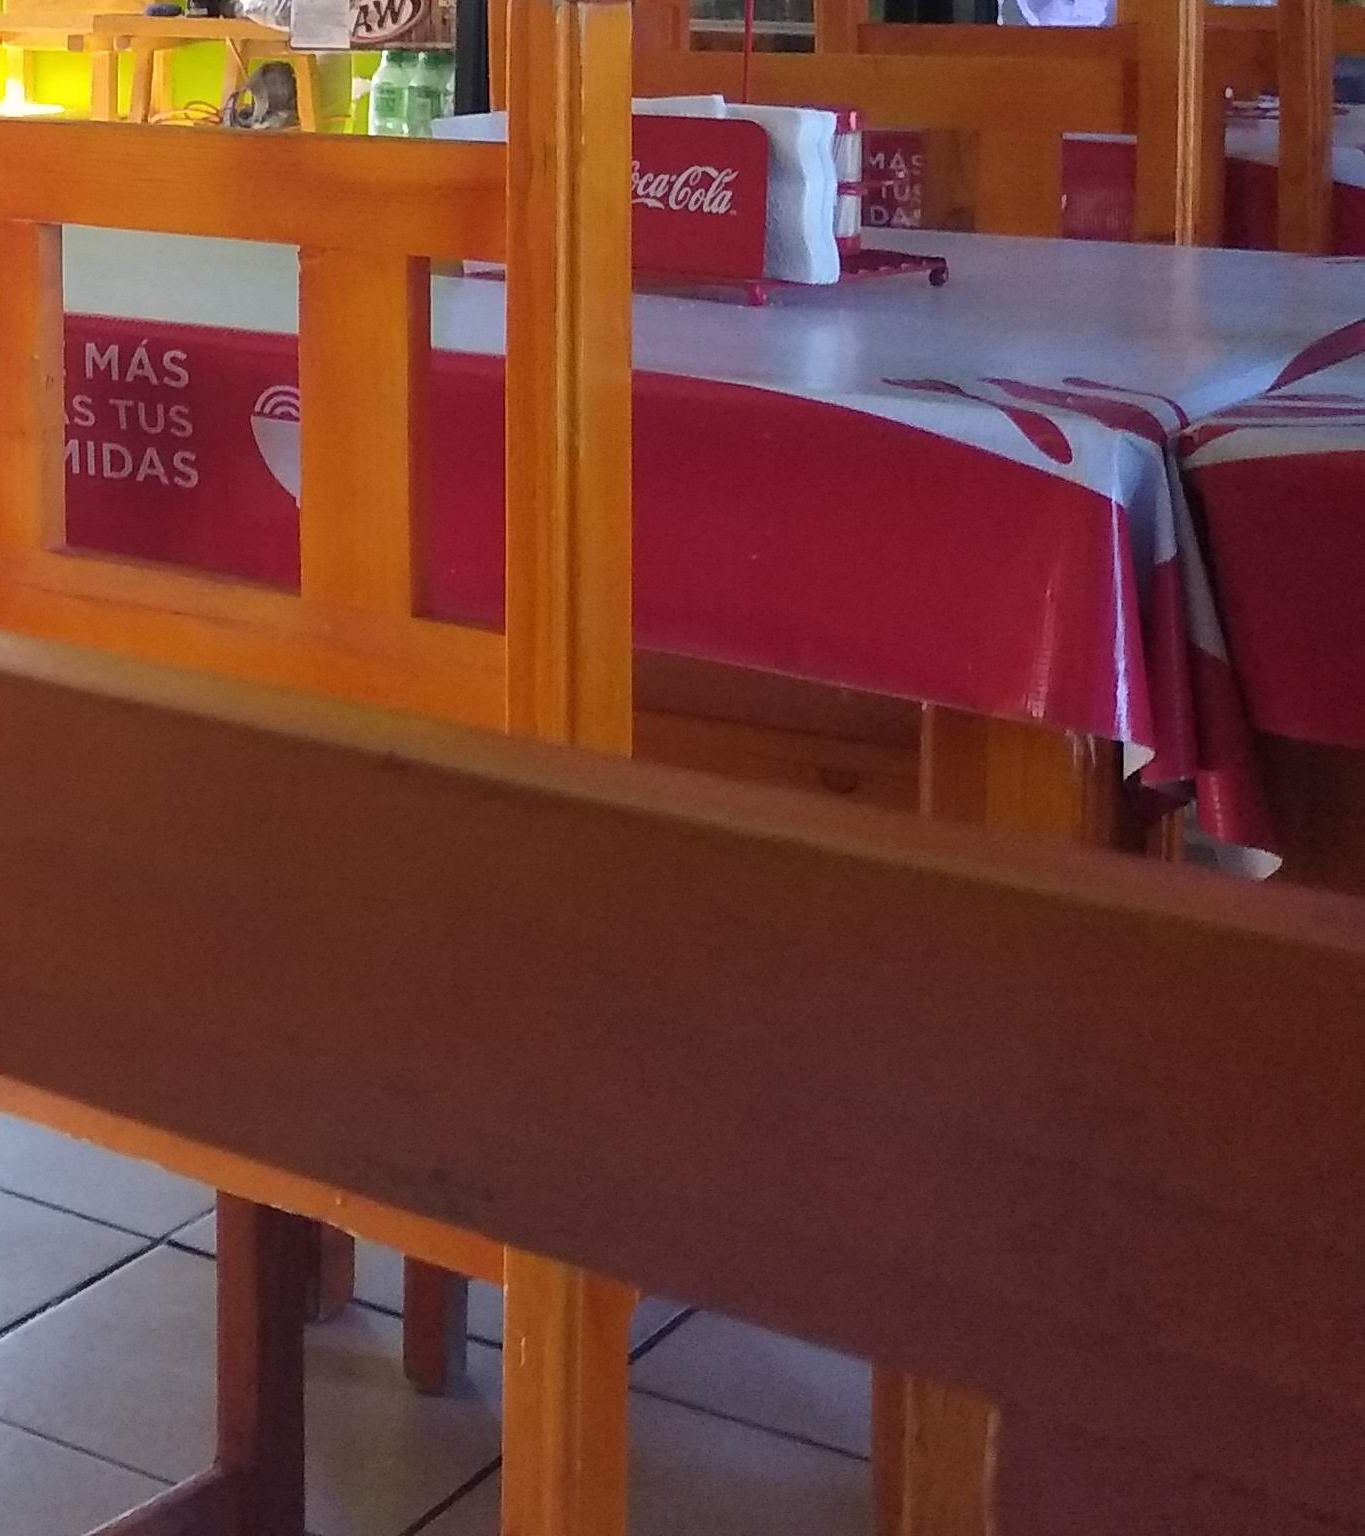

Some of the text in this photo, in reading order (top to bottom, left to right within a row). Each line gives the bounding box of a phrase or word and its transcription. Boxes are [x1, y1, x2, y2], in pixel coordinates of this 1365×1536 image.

[632, 161, 739, 214] oca-Cola
[84, 338, 190, 389] MÁS
[65, 394, 193, 438] S TUS
